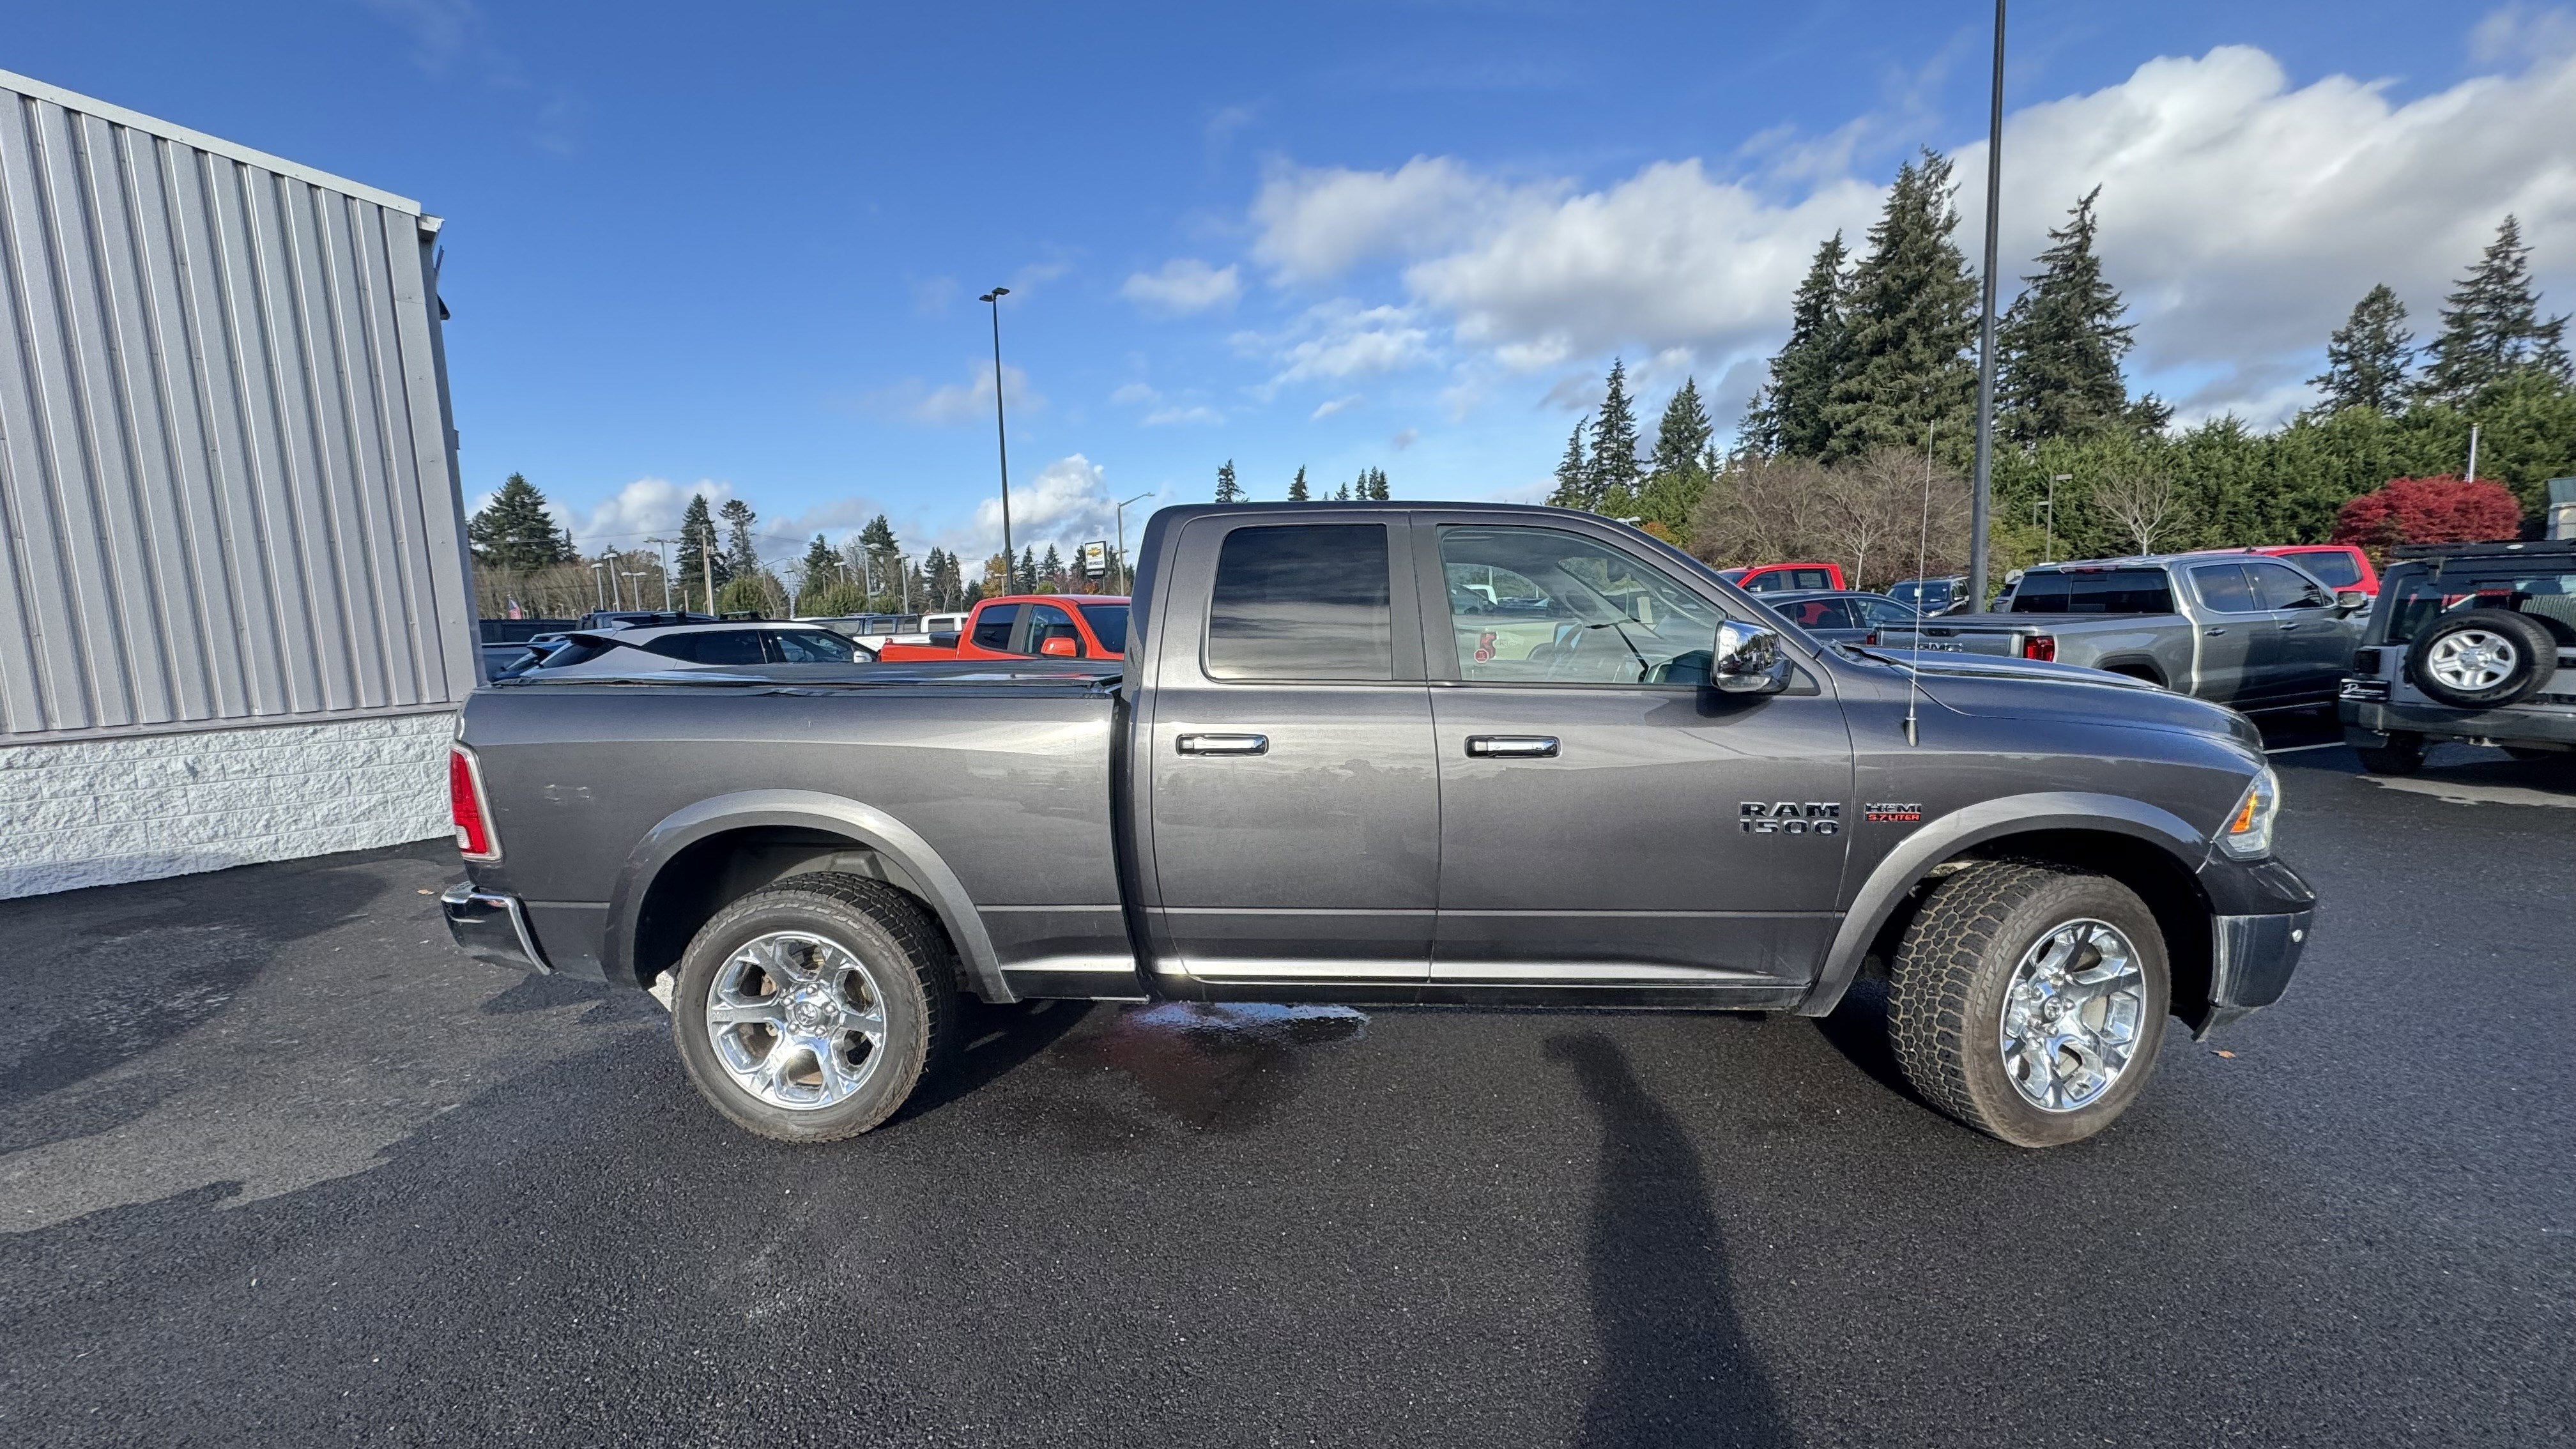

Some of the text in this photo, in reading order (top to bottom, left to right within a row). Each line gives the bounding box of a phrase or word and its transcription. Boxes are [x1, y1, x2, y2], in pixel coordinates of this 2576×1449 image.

[1917, 642, 1963, 652] GMC
[1739, 801, 1841, 818] RAM
[1865, 802, 1922, 813] HEMI
[1739, 818, 1841, 834] 1500
